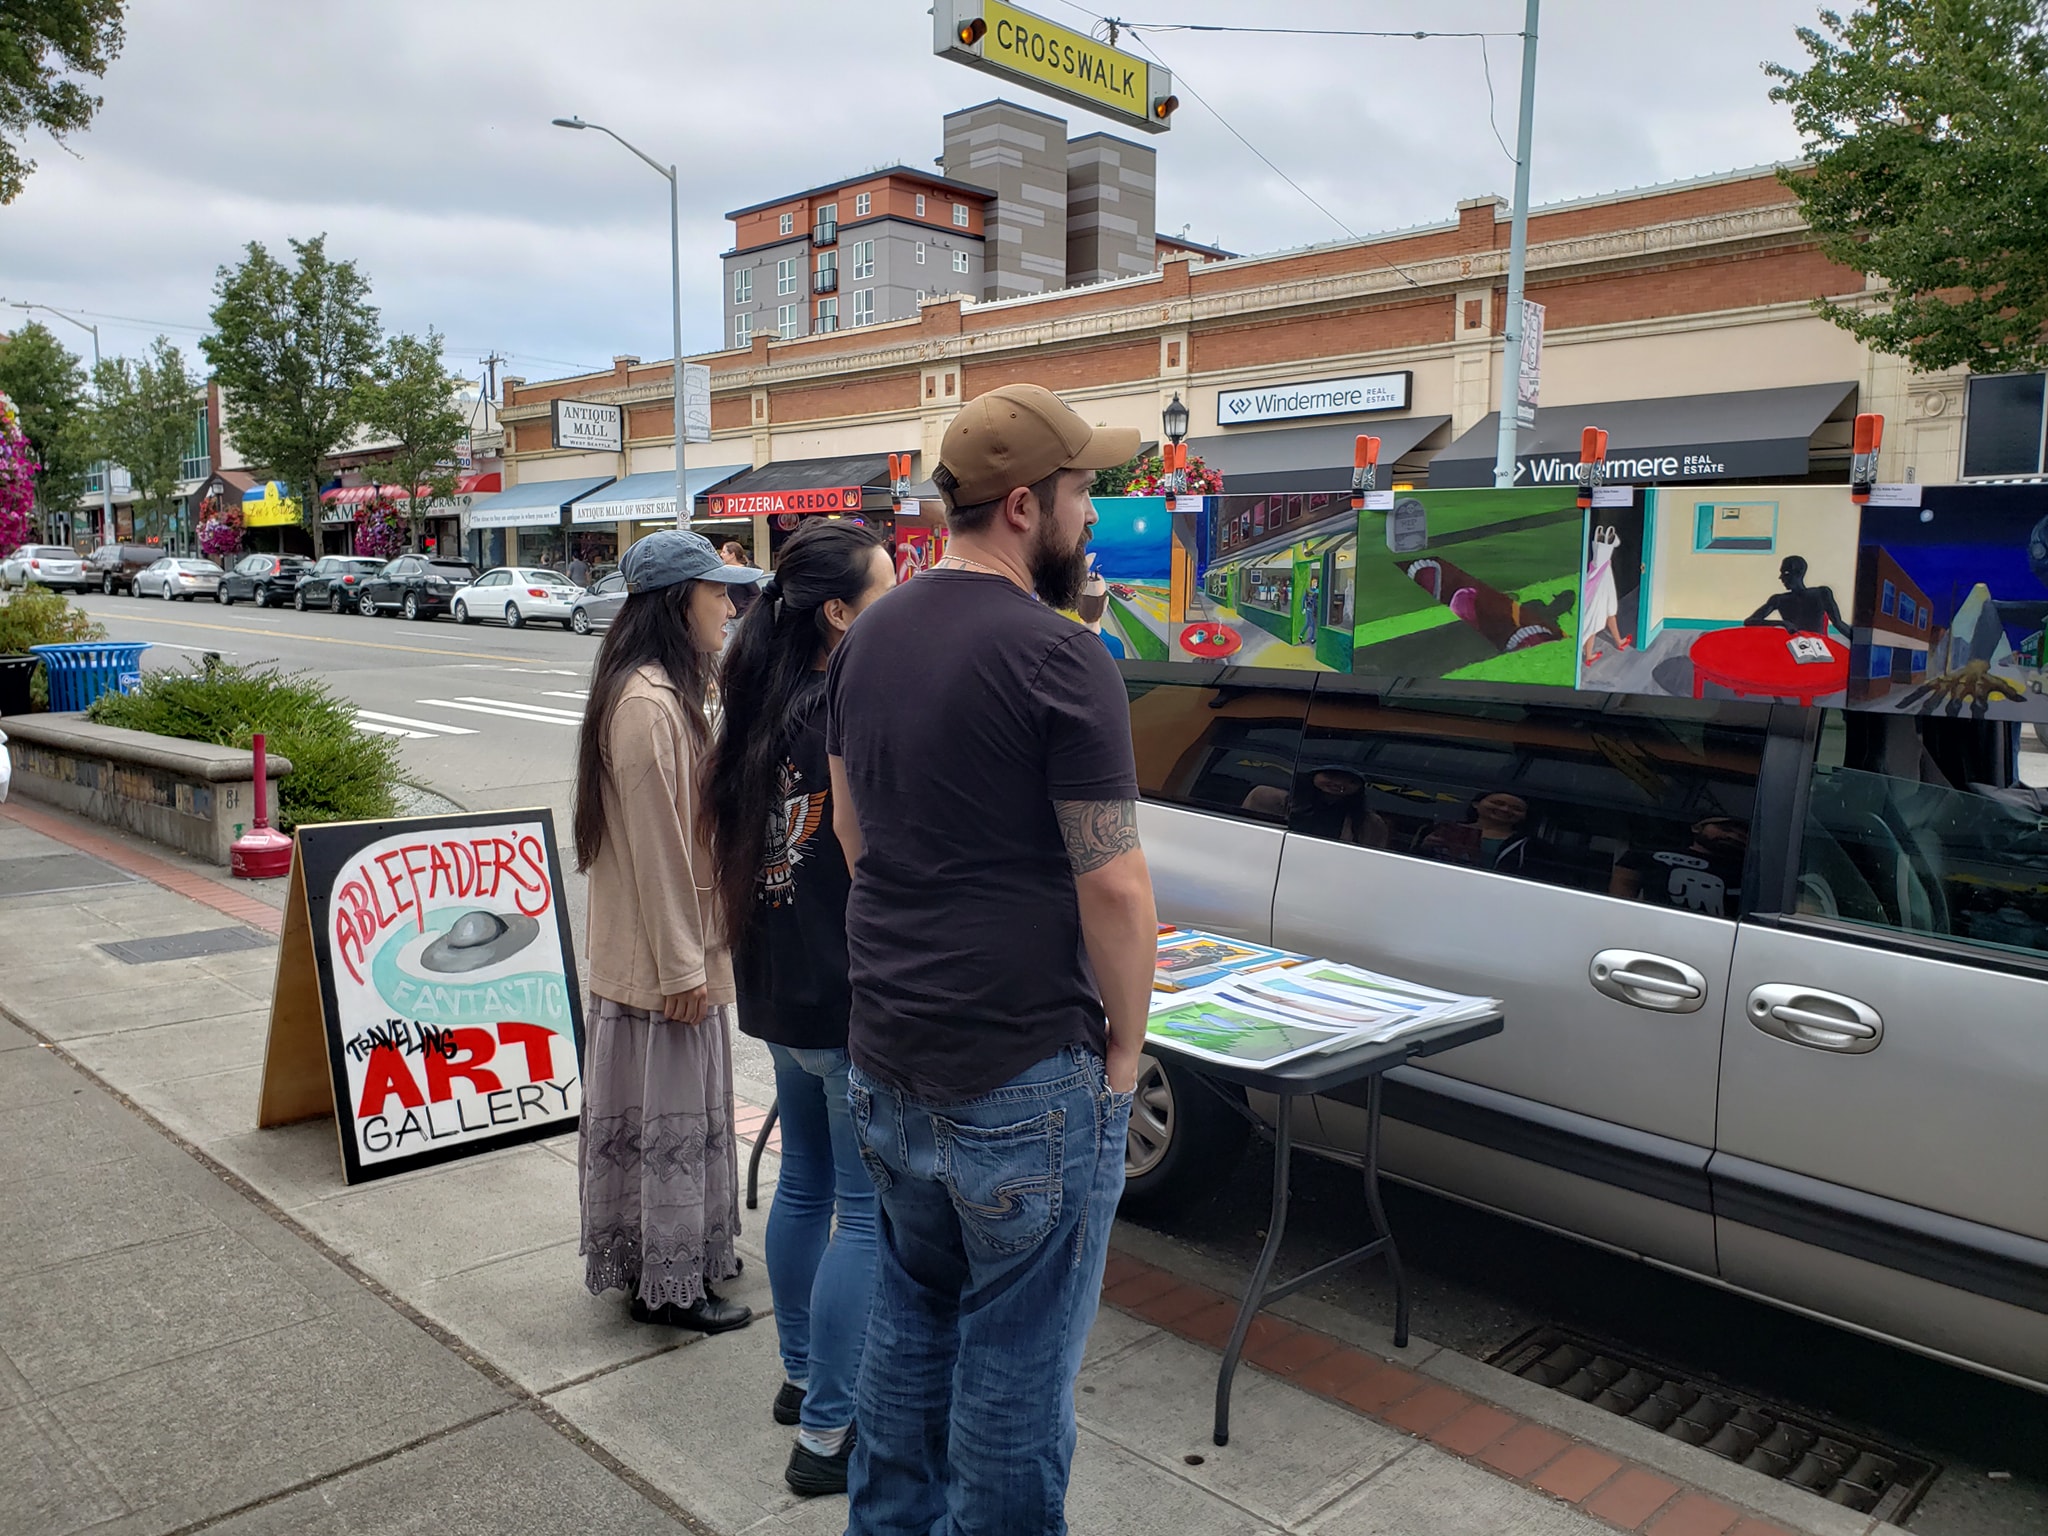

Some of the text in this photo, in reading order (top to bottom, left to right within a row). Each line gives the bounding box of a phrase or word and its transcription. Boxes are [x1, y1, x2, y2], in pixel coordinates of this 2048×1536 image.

[997, 19, 1135, 99] CROSSWALK
[1255, 389, 1362, 414] Windermere
[1366, 387, 1387, 396] REAL
[1366, 394, 1396, 404] ESTATE
[564, 406, 617, 424] ANTIQUE
[574, 422, 608, 437] MALL
[587, 441, 612, 449] SEATTLE
[1529, 456, 1679, 482] Winrmere
[1683, 455, 1712, 465] REAL
[1683, 463, 1725, 475] ESTATE
[577, 506, 605, 520] ANTIQUE
[605, 504, 625, 517] MALL
[625, 504, 634, 514] OF
[635, 502, 656, 515] WEST
[728, 493, 838, 513] PIZZERIA CREDO
[336, 830, 552, 985] ABLEFADER'S
[390, 976, 564, 1019] FANTASTIC
[346, 1018, 458, 1062] TRAVELING
[357, 1022, 559, 1120] ART
[362, 1076, 577, 1153] GALLERY
